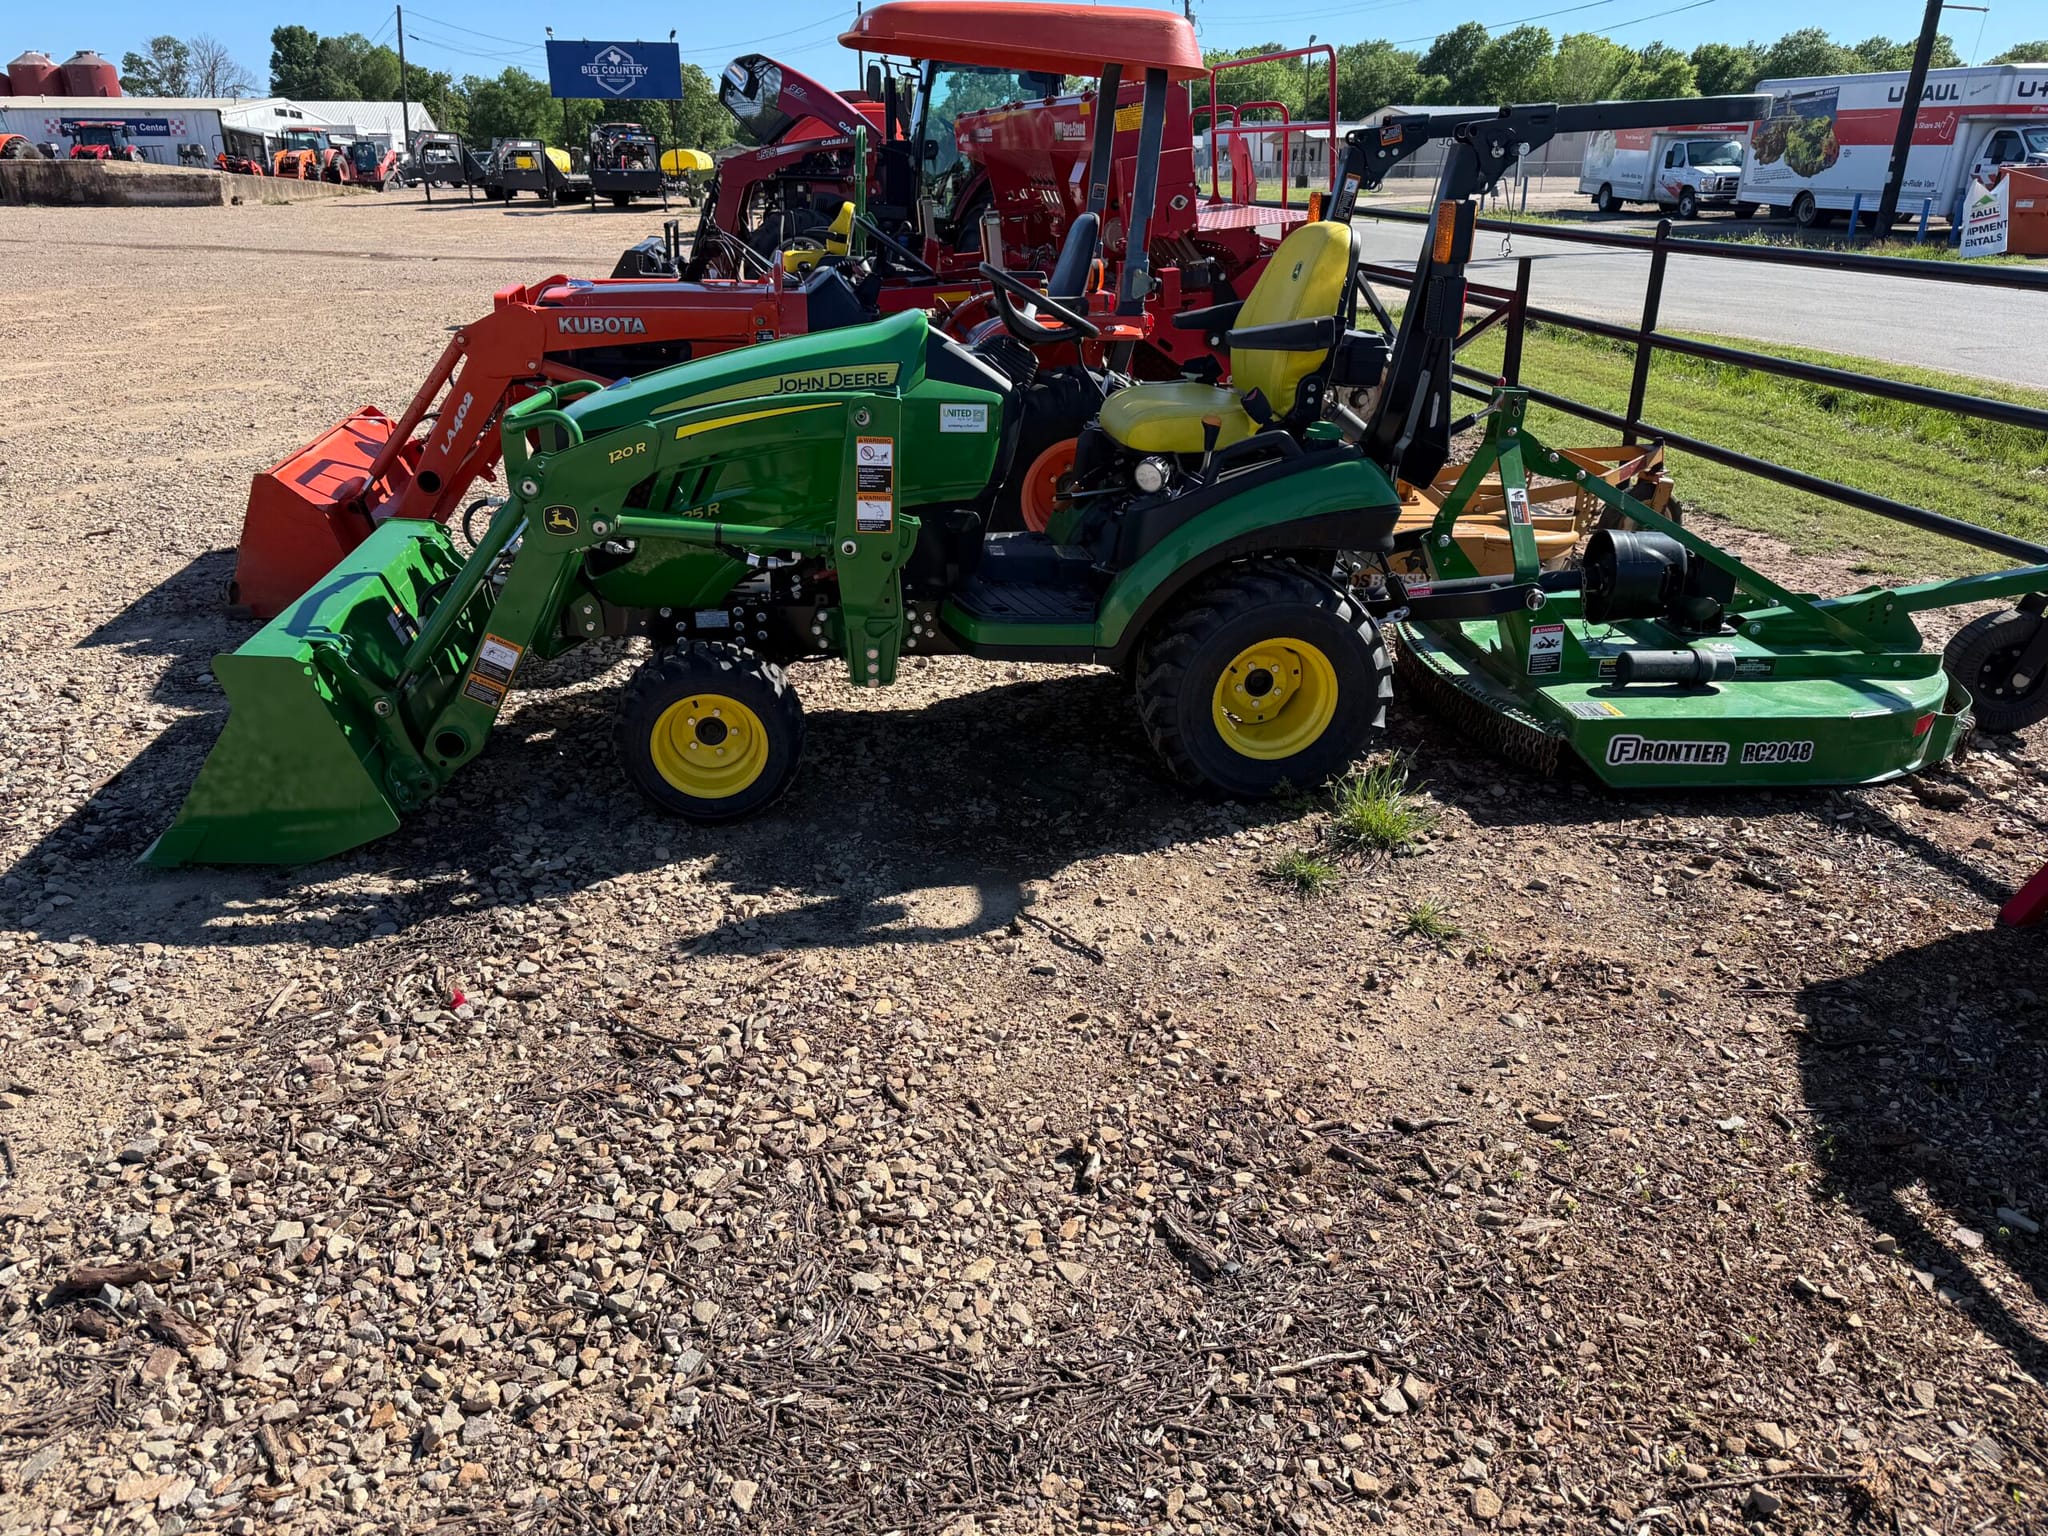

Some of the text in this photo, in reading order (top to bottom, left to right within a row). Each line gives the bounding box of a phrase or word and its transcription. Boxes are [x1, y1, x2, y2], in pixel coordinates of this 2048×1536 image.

[581, 65, 648, 75] BIG COUNTRY
[139, 123, 168, 132] Center
[838, 121, 857, 136] CAS
[821, 139, 841, 147] CASE
[558, 316, 648, 334] KUBOTA
[773, 371, 889, 395] JOHN DEERE
[942, 408, 972, 418] UNITED
[440, 391, 474, 456] LA402
[608, 441, 647, 464] 120 R
[707, 502, 721, 517] R
[1540, 625, 1562, 633] DANGER
[1607, 736, 1813, 764] FRONTIER RC2048
